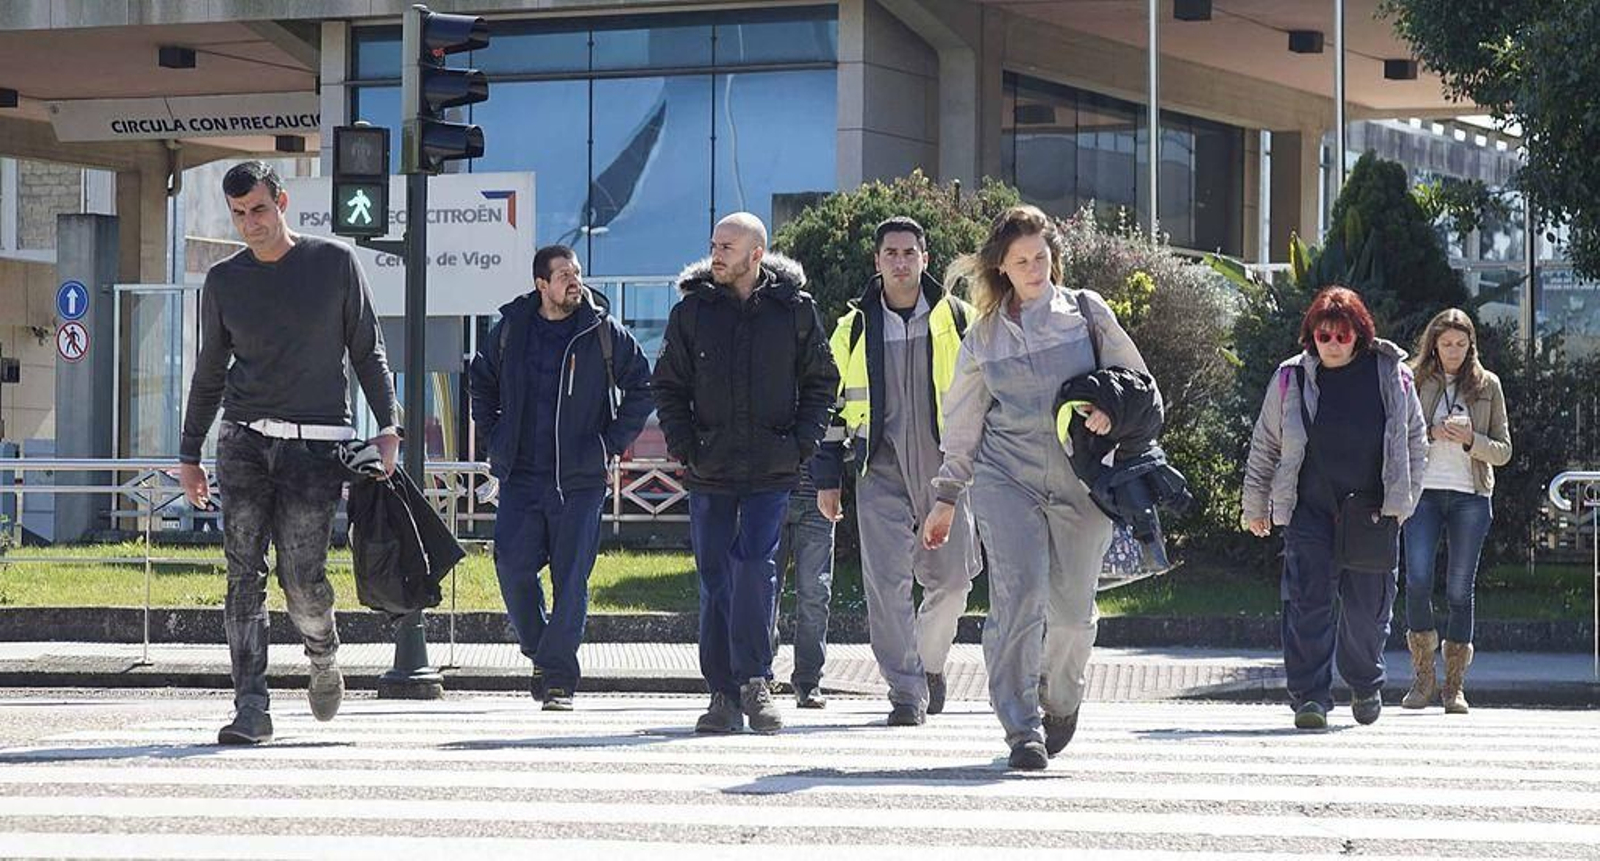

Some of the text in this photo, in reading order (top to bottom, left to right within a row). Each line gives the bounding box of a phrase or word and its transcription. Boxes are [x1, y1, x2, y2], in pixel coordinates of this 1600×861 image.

[111, 119, 187, 133] CIRCULA
[189, 117, 229, 132] CON
[299, 211, 332, 226] PSA
[426, 204, 501, 224] CITROËN
[436, 252, 457, 266] de
[462, 251, 501, 269] Vigo
